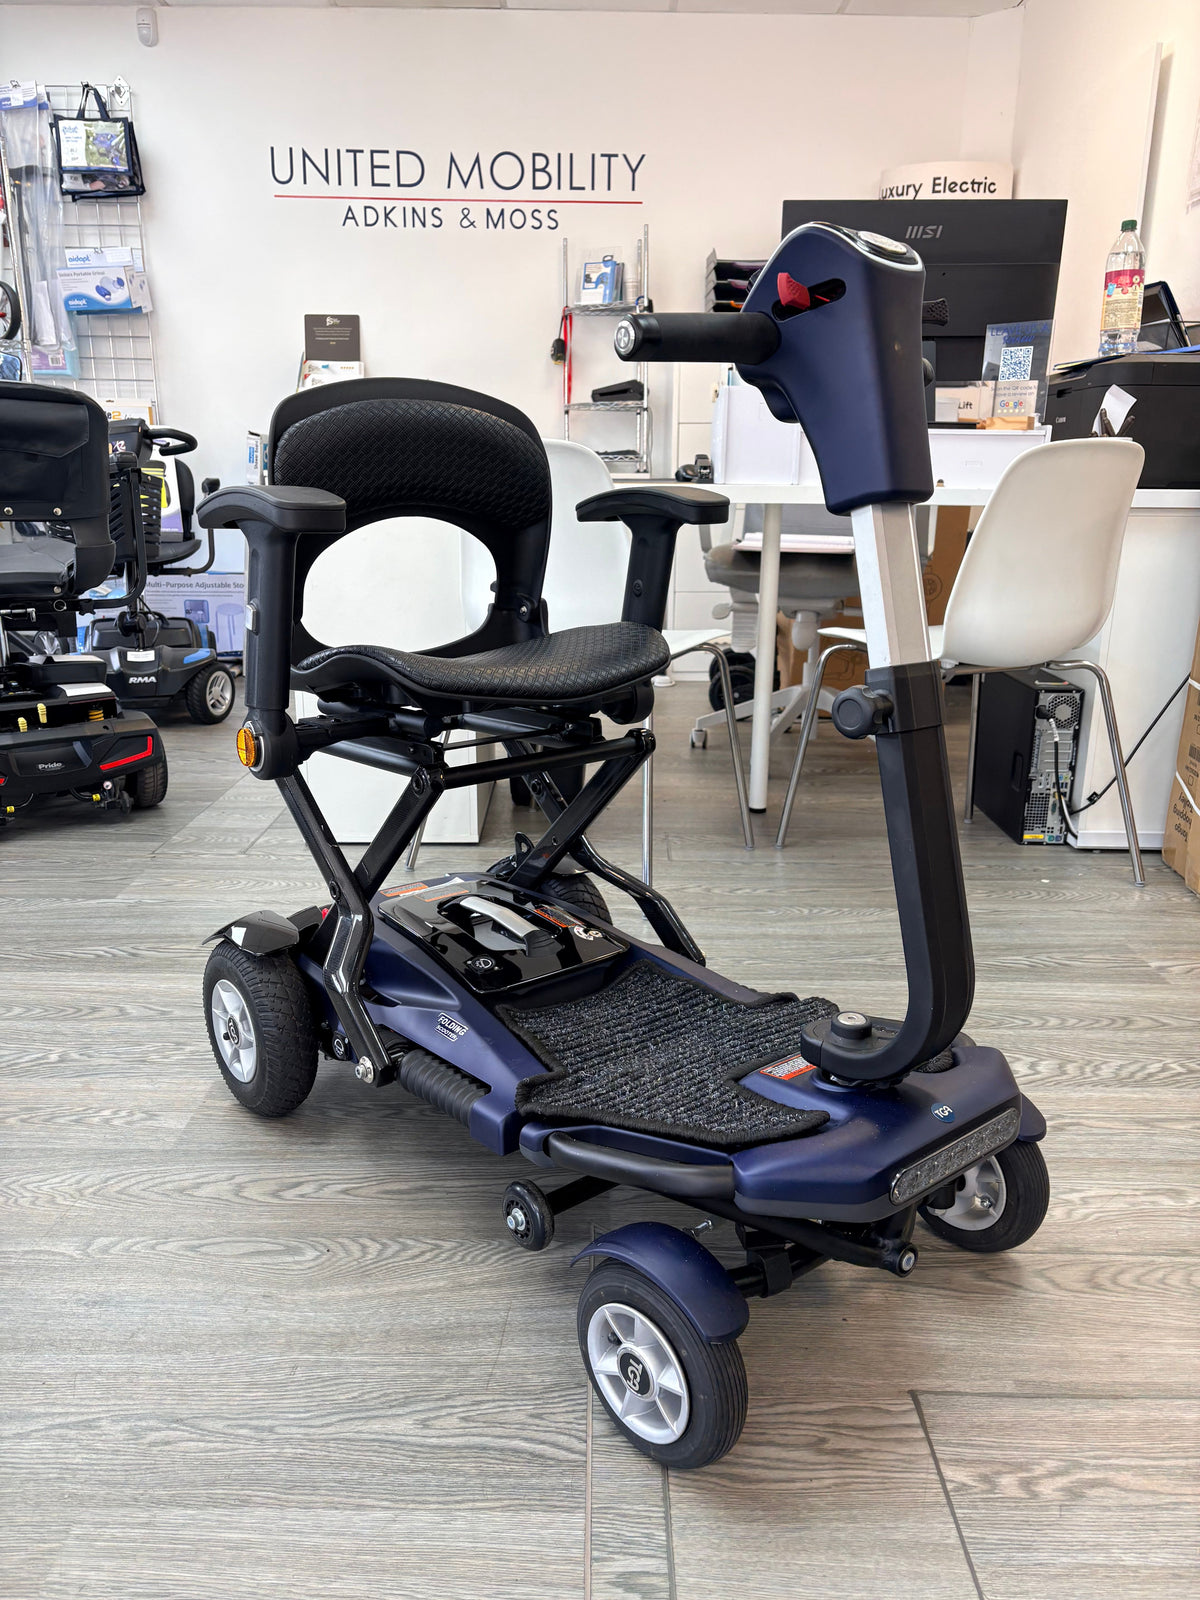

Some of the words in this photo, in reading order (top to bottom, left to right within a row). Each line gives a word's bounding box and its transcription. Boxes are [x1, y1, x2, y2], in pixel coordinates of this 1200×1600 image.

[270, 147, 424, 188] UNITED
[447, 151, 646, 192] MOBILITY
[878, 182, 923, 200] uxury
[932, 176, 998, 194] Electric
[342, 206, 443, 229] ADKINS
[460, 208, 477, 229] &
[487, 208, 559, 230] MOSS
[905, 225, 943, 239] MSI
[958, 401, 974, 410] Lift
[999, 400, 1024, 409] Google
[195, 581, 231, 590] Adjustable
[233, 581, 244, 590] Sto
[128, 676, 157, 685] RMA
[38, 762, 62, 770] Pride
[438, 1016, 467, 1036] FOLDING
